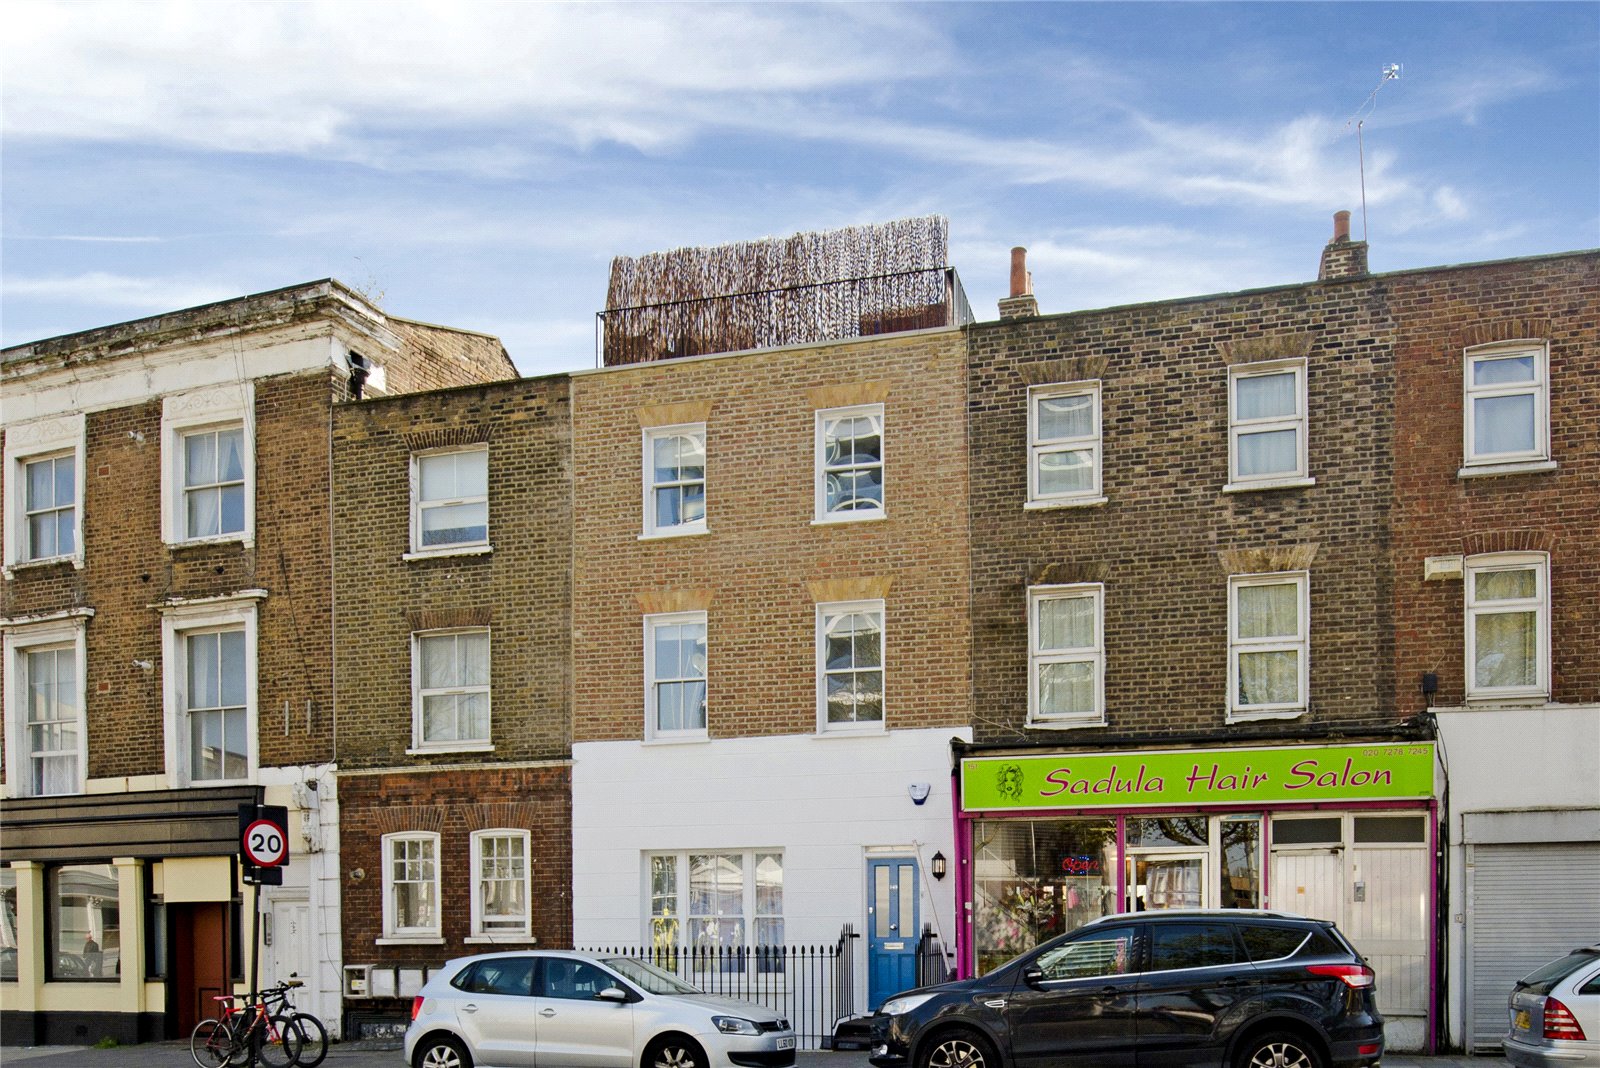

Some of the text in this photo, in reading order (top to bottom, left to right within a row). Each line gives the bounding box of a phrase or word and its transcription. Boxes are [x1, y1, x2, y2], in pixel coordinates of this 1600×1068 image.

[1363, 748, 1379, 757] 020
[1383, 747, 1404, 757] 7278
[1040, 758, 1392, 796] Sadula Hair Salon
[252, 834, 281, 853] 20
